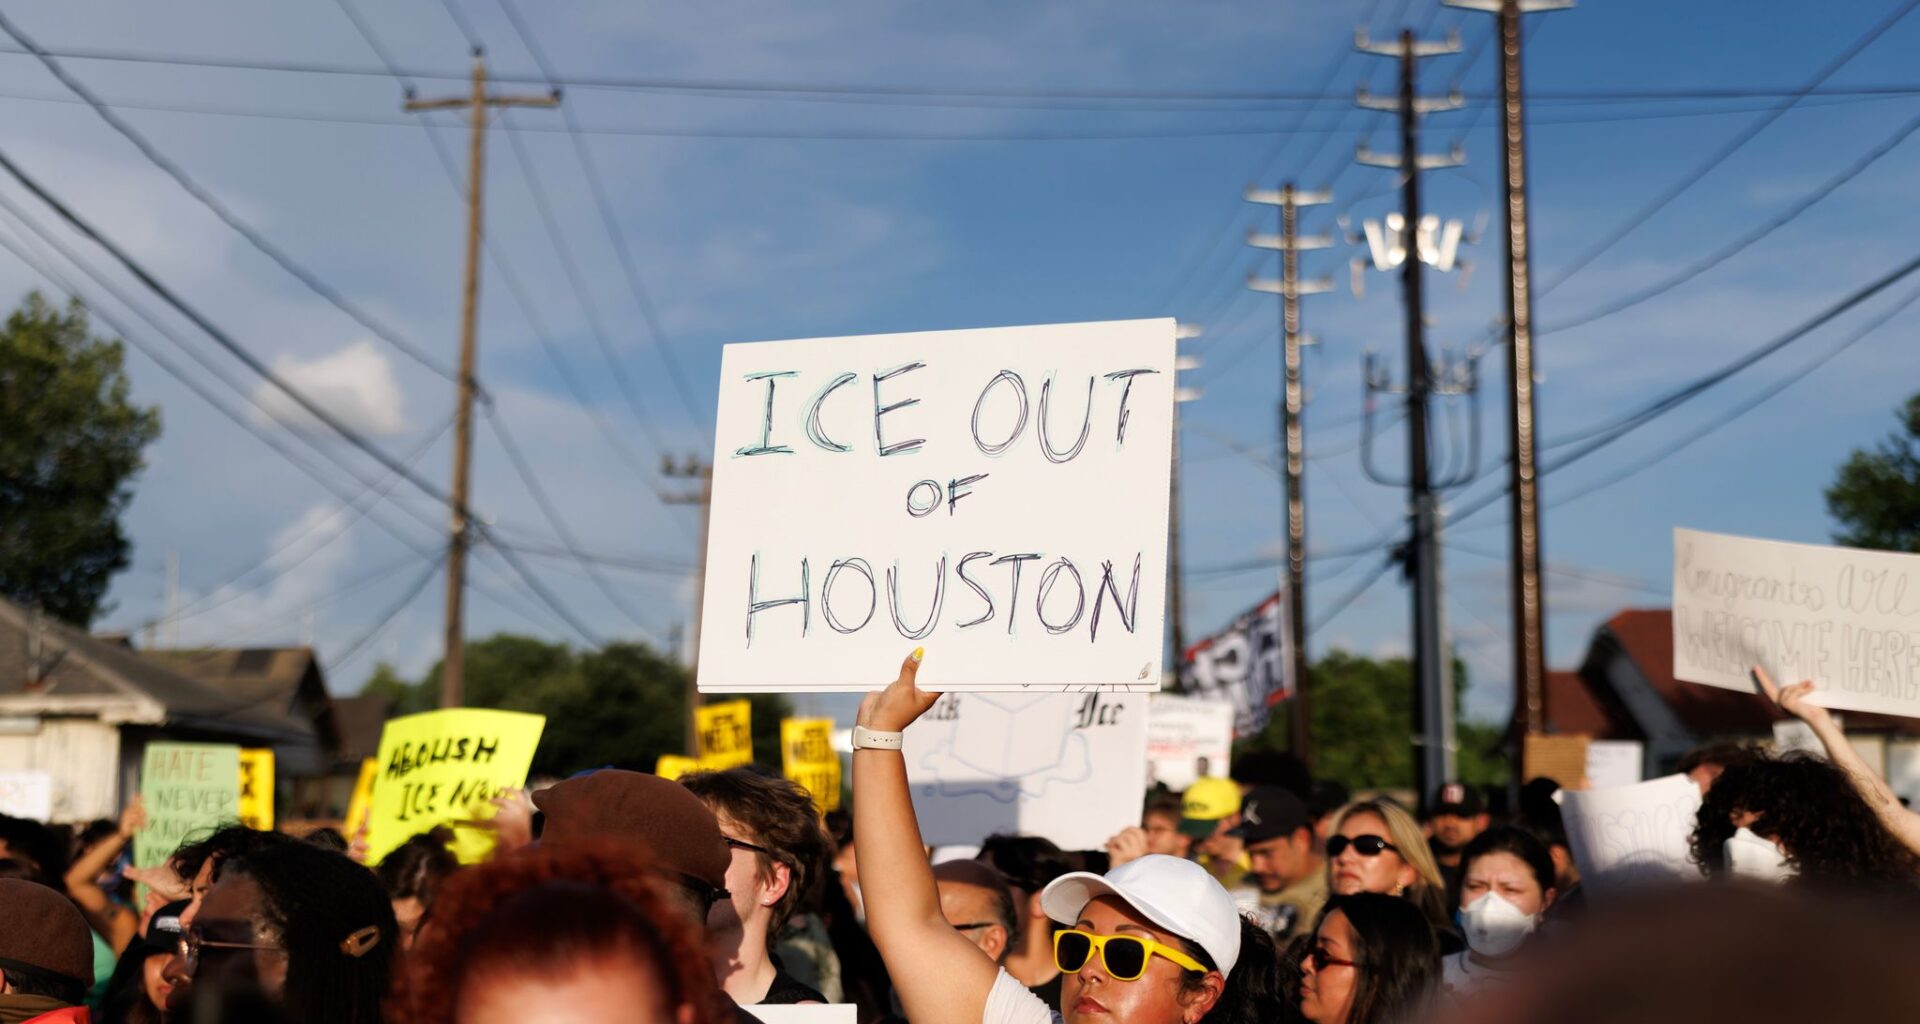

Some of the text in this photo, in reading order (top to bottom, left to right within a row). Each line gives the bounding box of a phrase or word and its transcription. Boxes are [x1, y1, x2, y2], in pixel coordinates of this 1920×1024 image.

[732, 361, 1160, 464] ICE OUT
[906, 473, 990, 518] OF
[745, 550, 1143, 649] HOUSTON
[1840, 622, 1920, 701] HERE
[151, 751, 216, 780] HATE
[387, 737, 499, 781] ABOLISH
[396, 782, 444, 821] ICE
